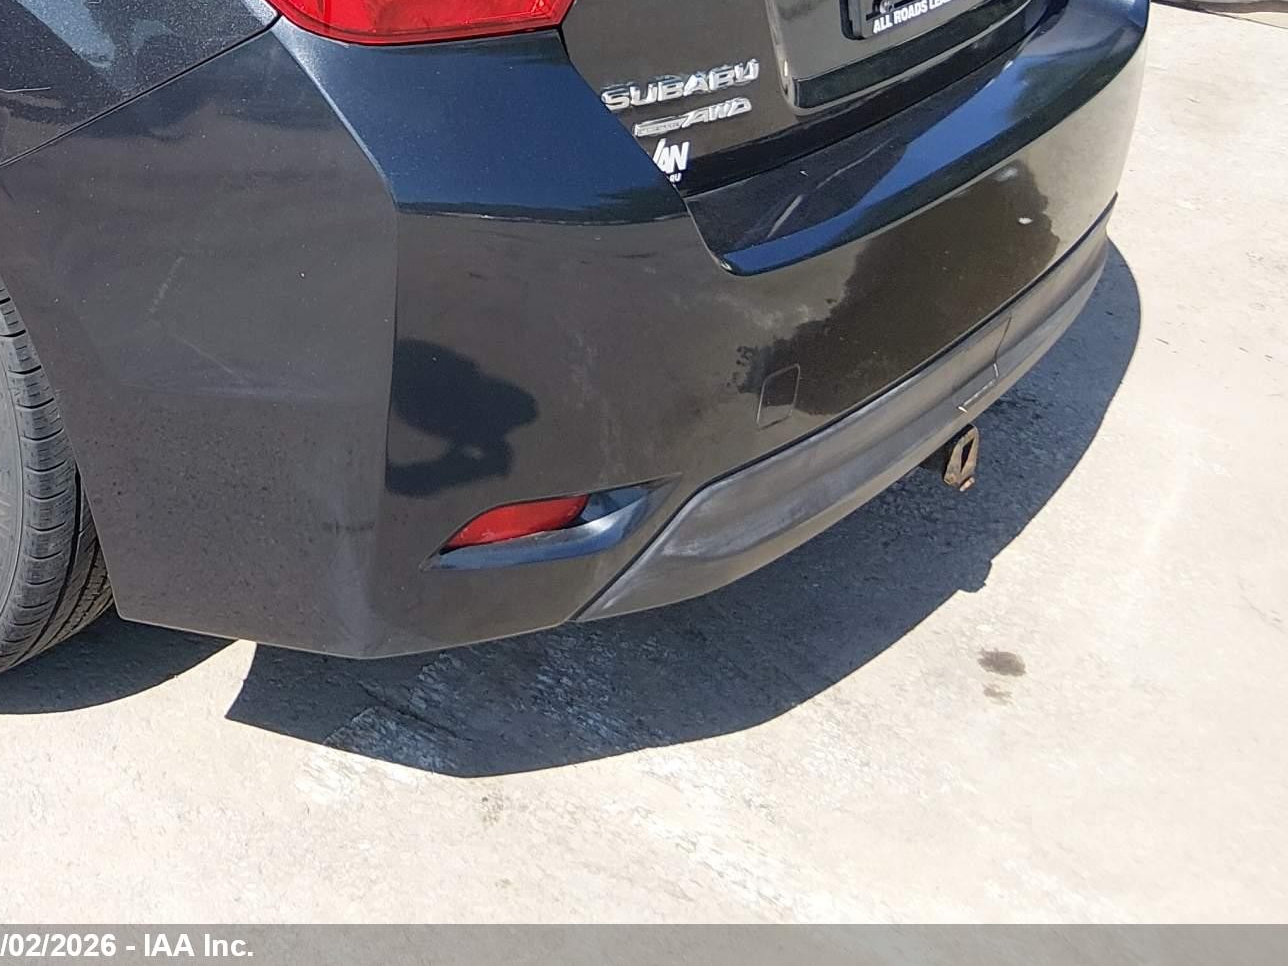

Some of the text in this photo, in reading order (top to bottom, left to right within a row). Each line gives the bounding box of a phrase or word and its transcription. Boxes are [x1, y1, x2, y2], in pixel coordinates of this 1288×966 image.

[873, 14, 893, 34] ALL
[893, 0, 928, 25] ROADS
[600, 58, 760, 111] SUBARU
[681, 96, 753, 129] AWD
